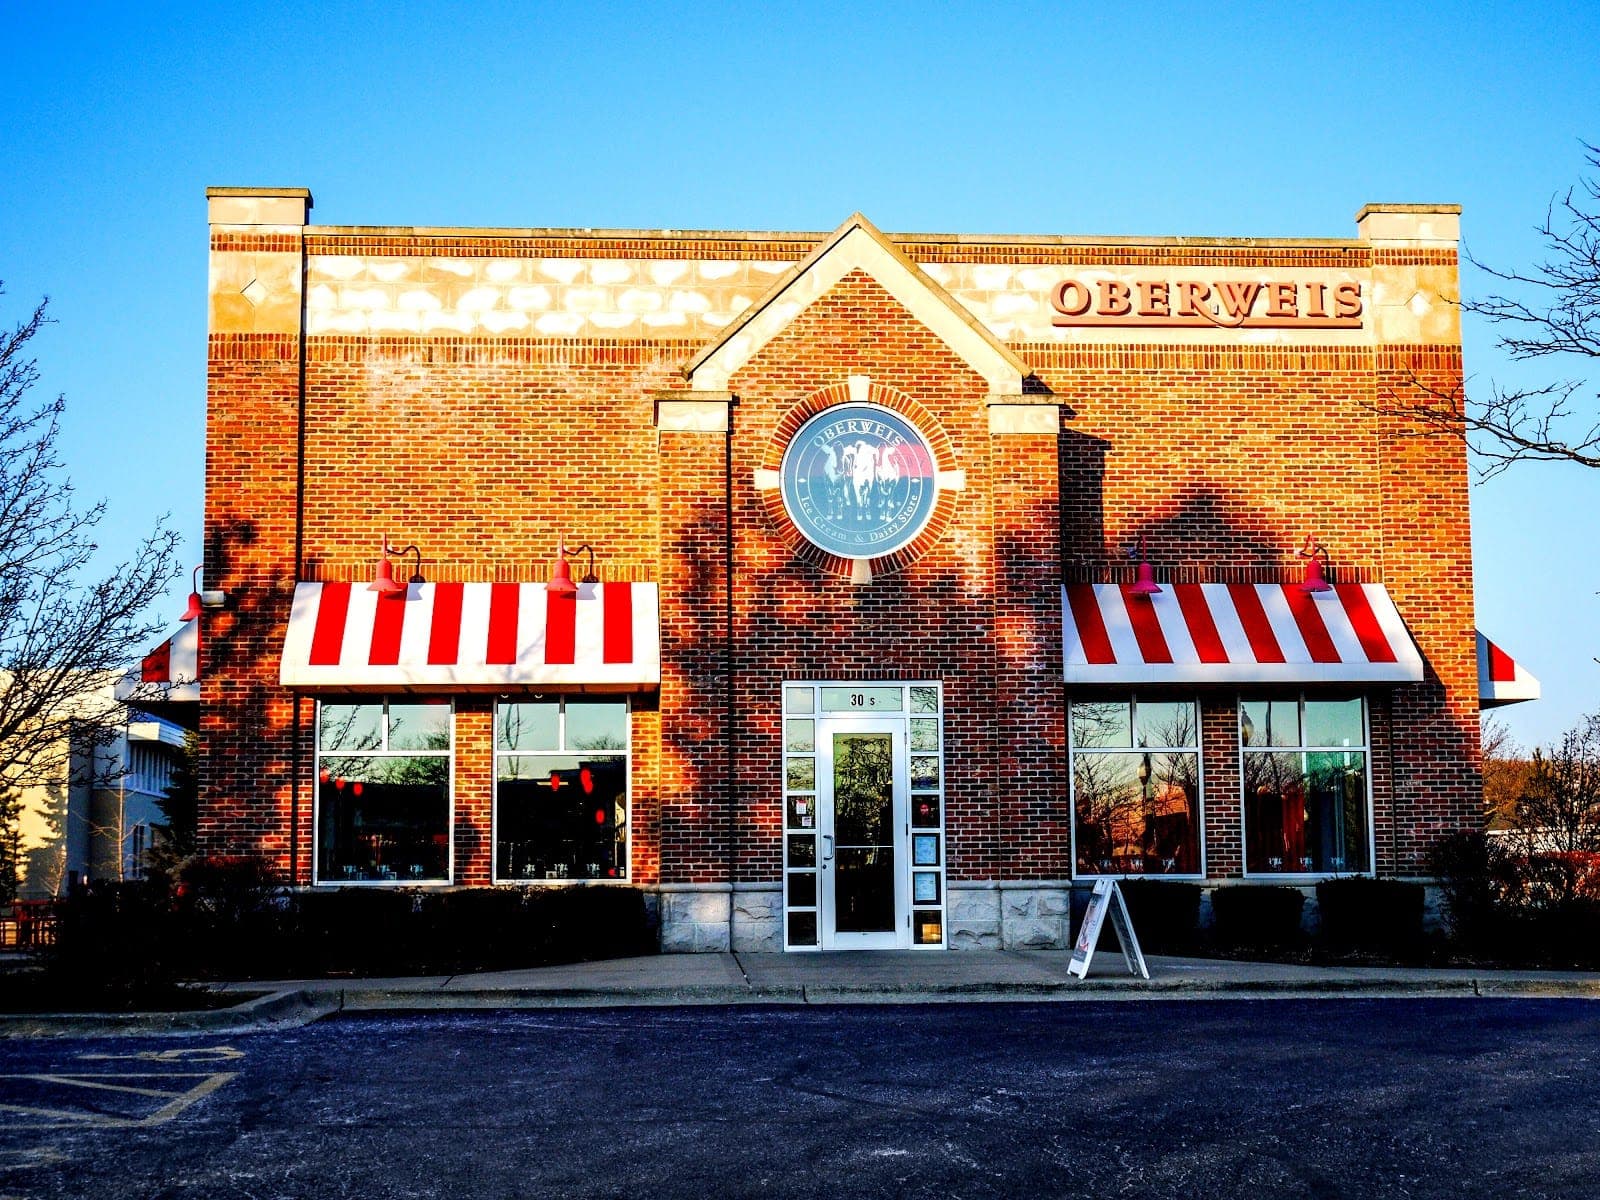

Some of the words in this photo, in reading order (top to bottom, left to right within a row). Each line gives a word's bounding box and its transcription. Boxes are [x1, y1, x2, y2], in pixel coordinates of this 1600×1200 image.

[1050, 279, 1363, 325] OBERWEIS
[813, 420, 904, 447] OBERWEIS
[801, 496, 813, 514] Ice
[813, 516, 847, 540] Cream
[855, 534, 864, 543] &
[869, 522, 899, 541] Dairy
[898, 494, 918, 523] Store
[850, 694, 864, 706] 30
